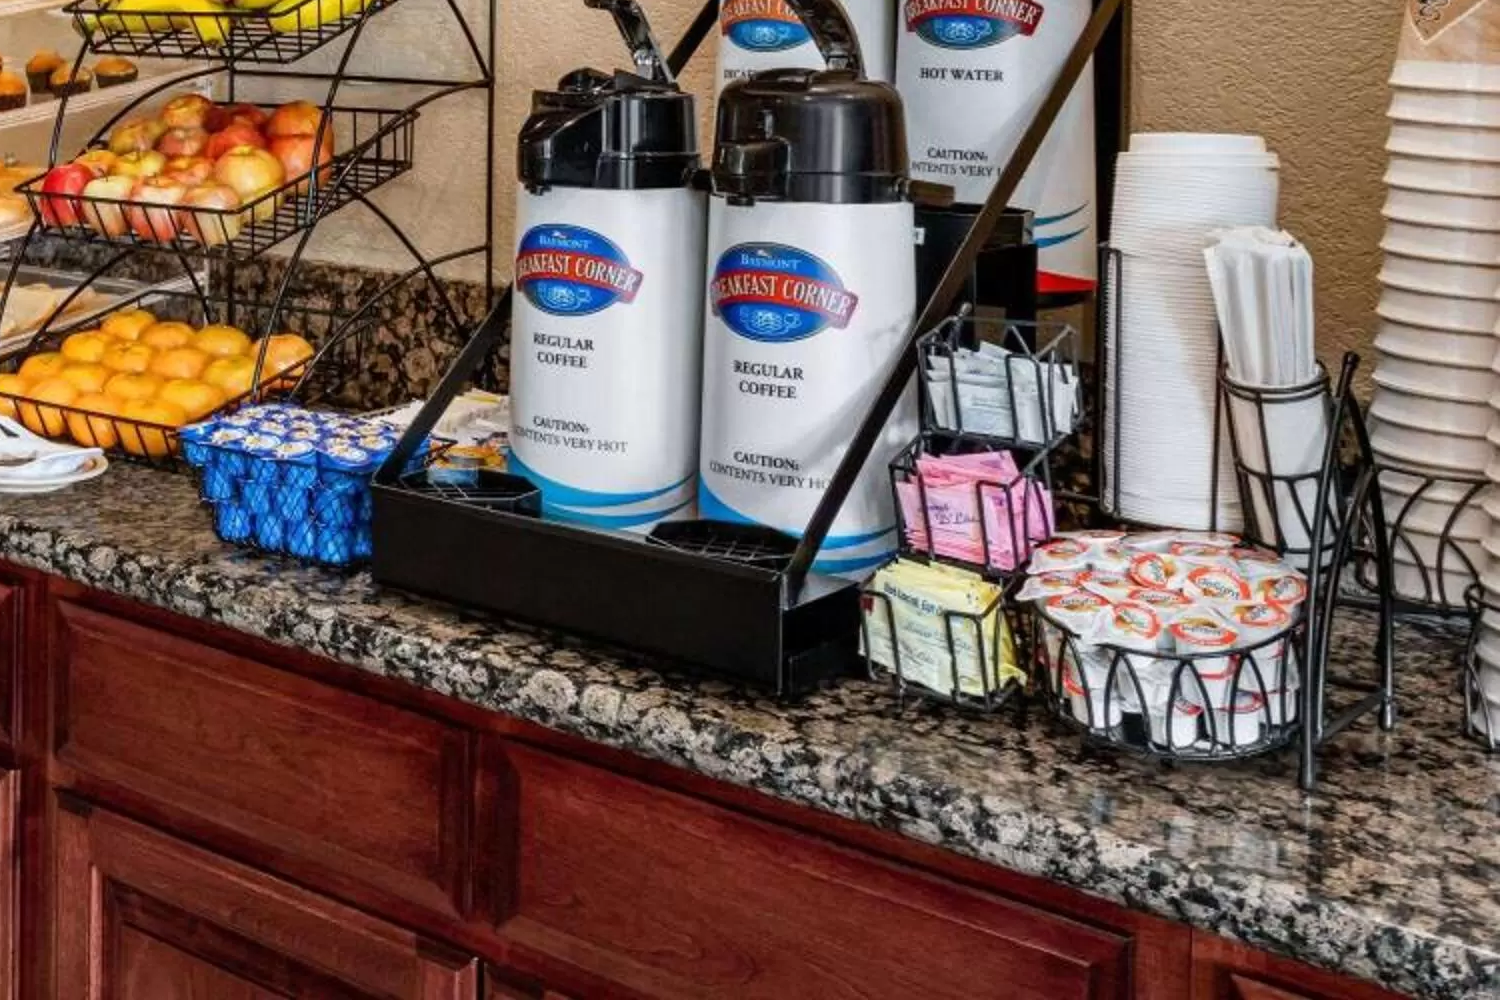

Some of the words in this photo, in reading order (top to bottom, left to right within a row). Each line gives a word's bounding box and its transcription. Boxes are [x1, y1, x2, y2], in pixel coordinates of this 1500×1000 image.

[920, 67, 948, 81] HOT
[951, 69, 1004, 82] WATER
[911, 161, 957, 175] NTENTS
[960, 164, 993, 177] VERY
[575, 257, 637, 293] CORNER
[783, 279, 850, 318] CORNER
[533, 331, 594, 351] REGULAR
[537, 351, 588, 369] COFFEE
[733, 359, 804, 380] REGULAR
[739, 379, 797, 399] COFFEE
[562, 436, 595, 450] VERY
[597, 439, 628, 453] HOT
[768, 472, 805, 488] VERY
